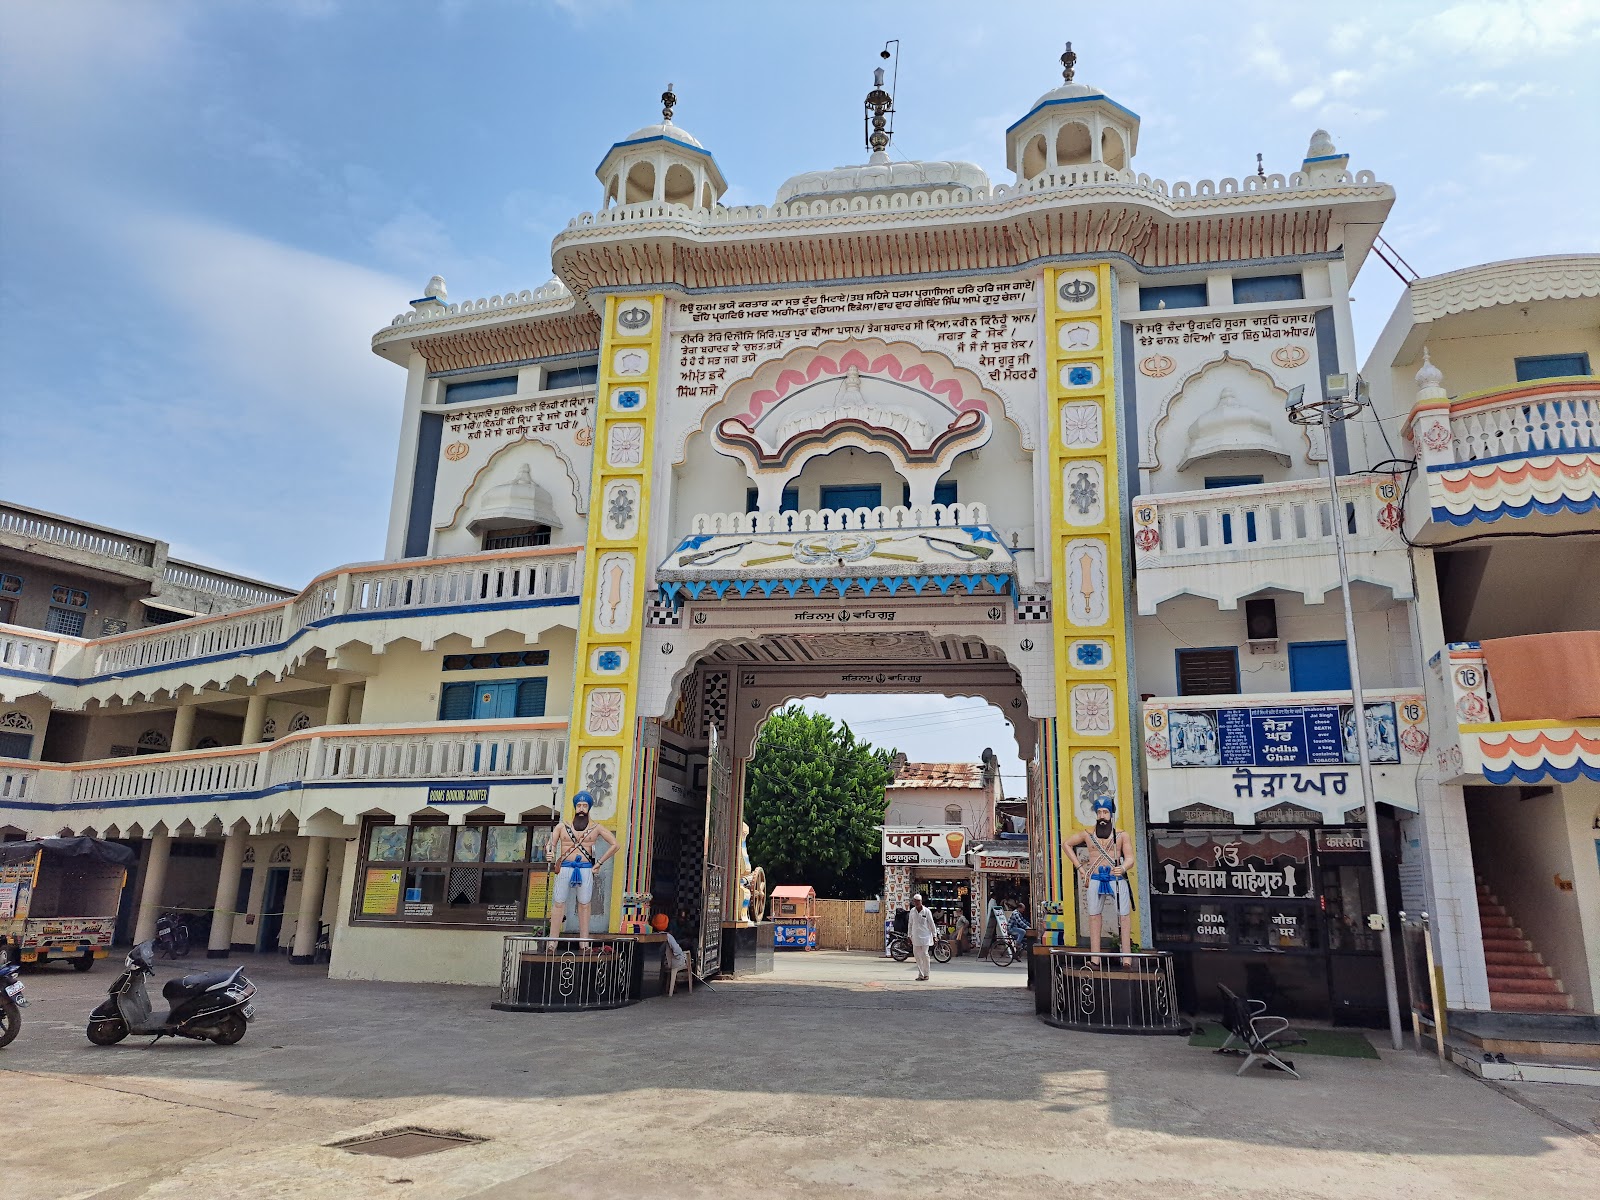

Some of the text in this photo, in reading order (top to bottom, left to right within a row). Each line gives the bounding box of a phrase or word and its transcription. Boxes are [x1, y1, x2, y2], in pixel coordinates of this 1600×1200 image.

[1262, 744, 1298, 754] Jodha
[1266, 754, 1296, 762] Ghar
[1232, 767, 1349, 798] ਜੋੜਾ ਘਰ
[886, 833, 941, 857] पवार
[1177, 864, 1283, 898] सतनाम वाहेगुरु
[1197, 913, 1225, 924] JODA
[1271, 913, 1297, 925] जोडा
[1197, 925, 1227, 936] GHAR
[1278, 928, 1295, 937] घर
